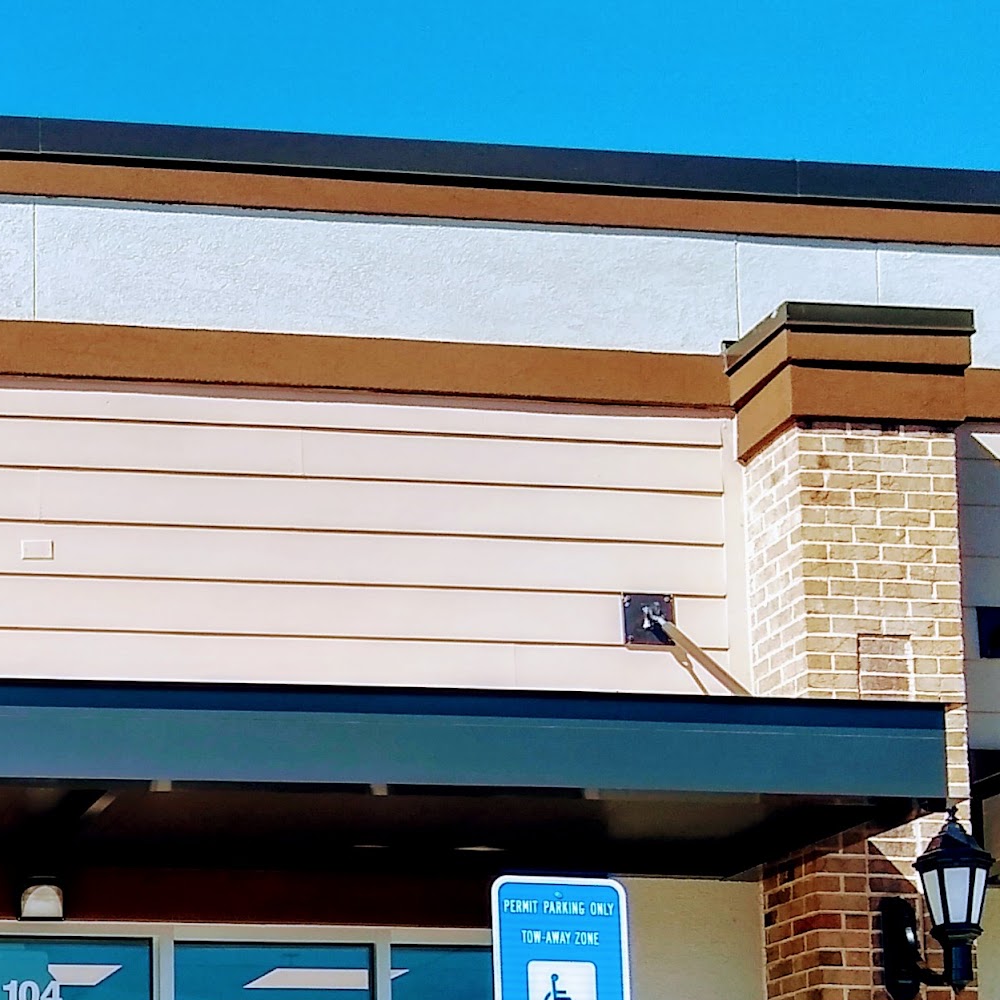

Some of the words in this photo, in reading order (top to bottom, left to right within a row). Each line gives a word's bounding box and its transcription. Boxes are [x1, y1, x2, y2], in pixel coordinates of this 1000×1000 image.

[503, 899, 538, 914] PERMIT
[543, 901, 585, 915] PARKING
[590, 902, 614, 916] ONLY
[521, 930, 571, 945] TOW-AWAY
[575, 931, 599, 946] ZONE
